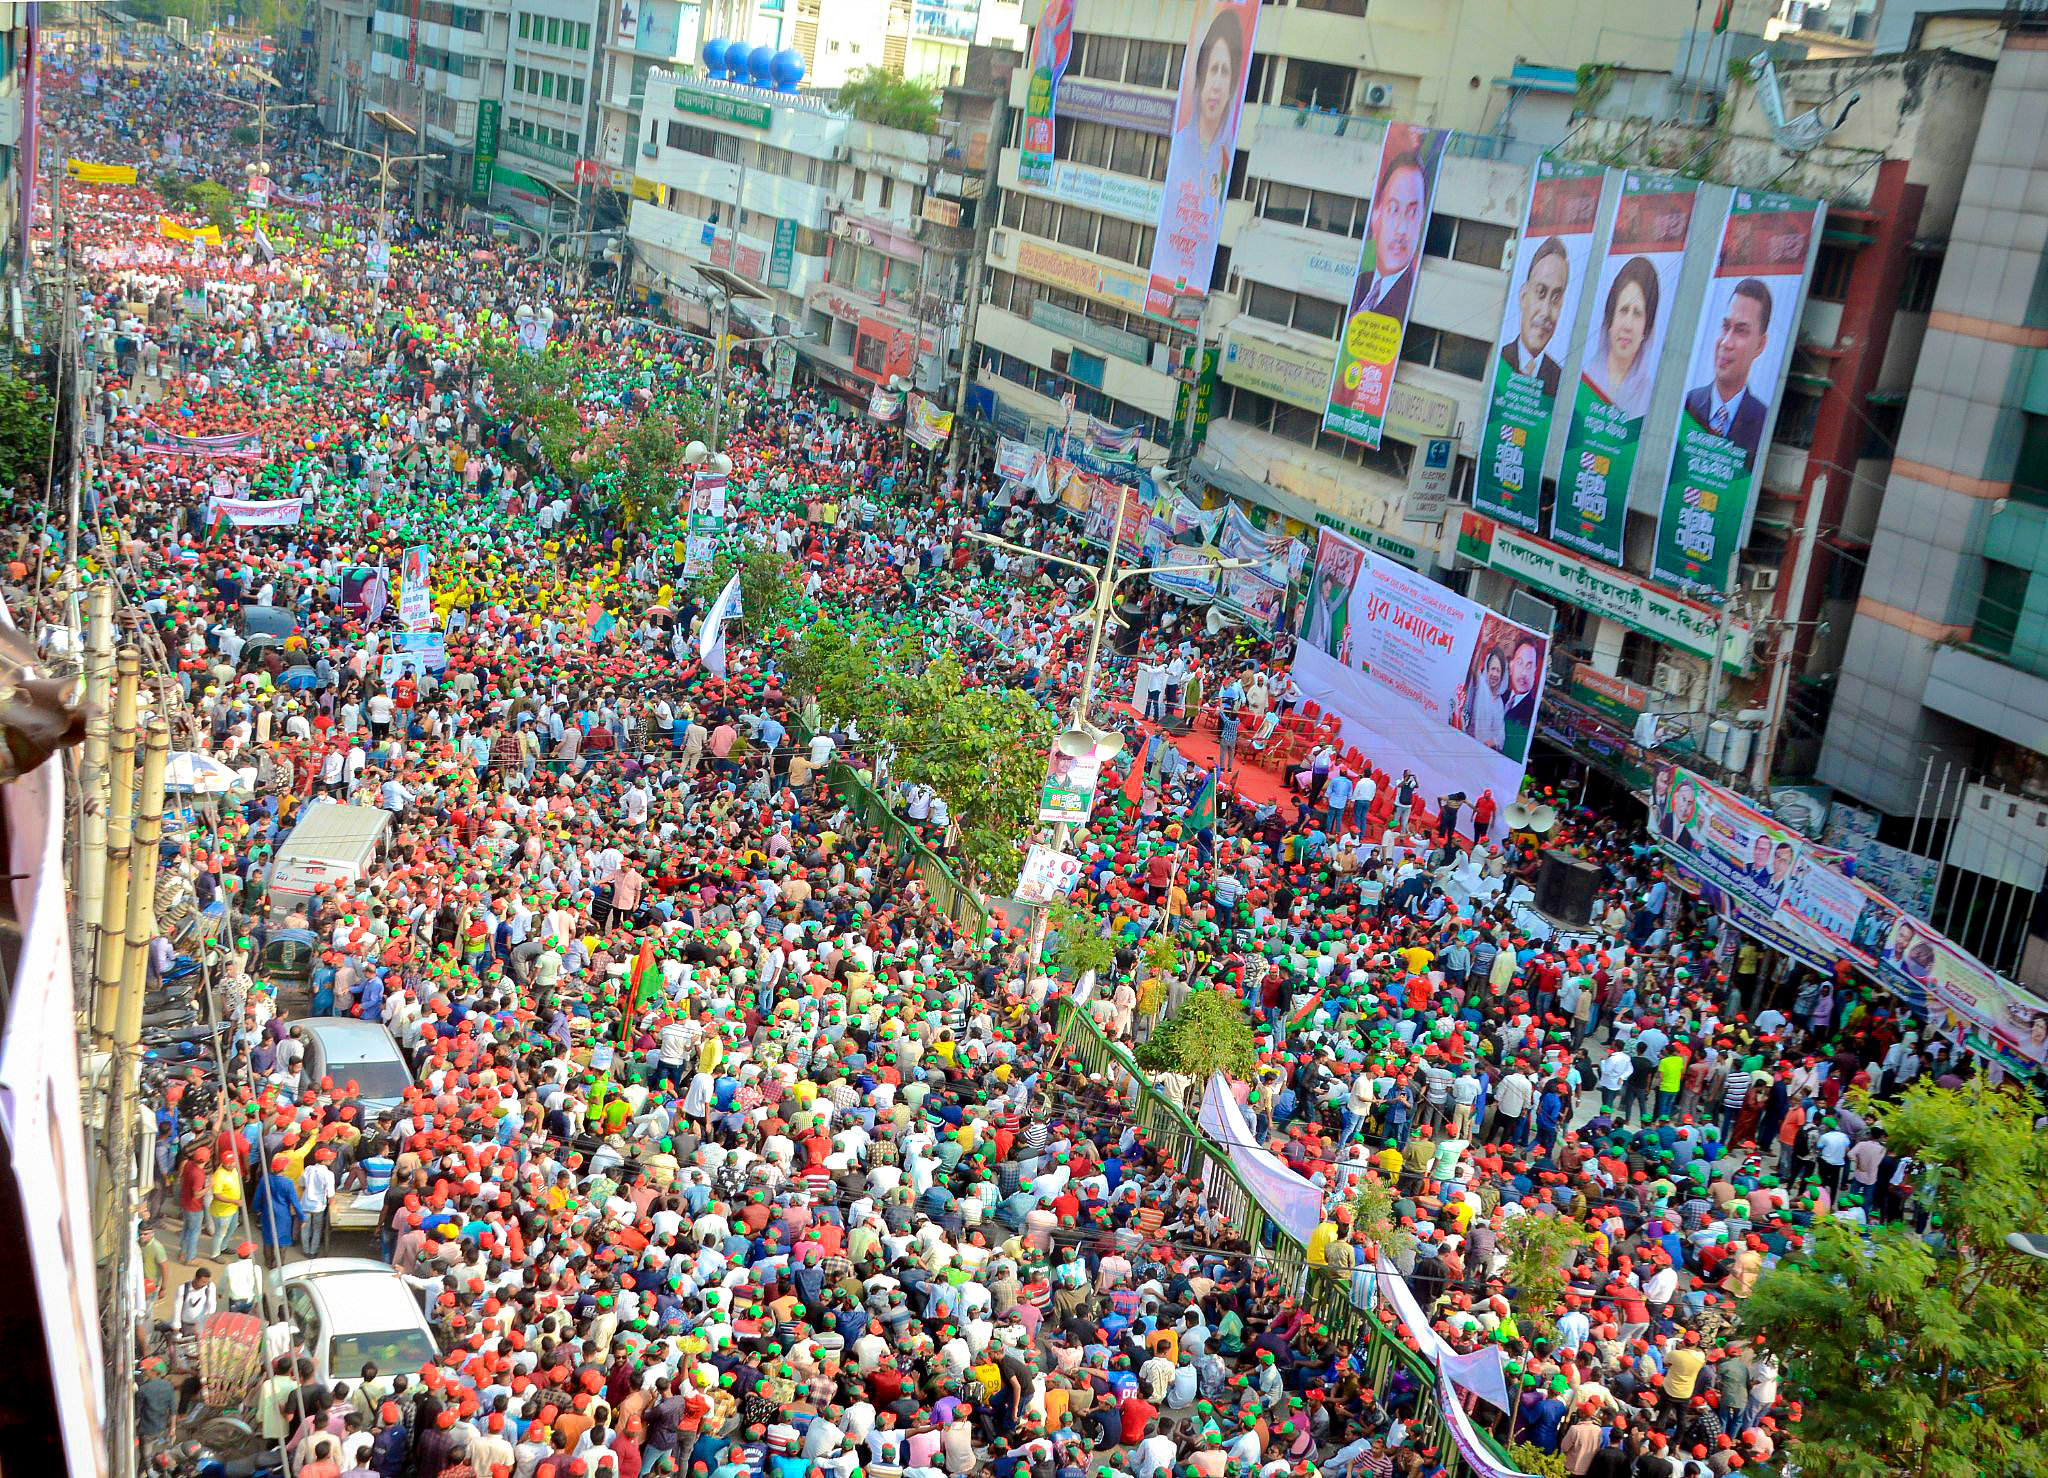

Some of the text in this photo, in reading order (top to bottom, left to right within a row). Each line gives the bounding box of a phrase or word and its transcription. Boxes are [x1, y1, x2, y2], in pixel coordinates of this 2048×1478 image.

[1415, 502, 1438, 513] LIMITED
[1315, 512, 1416, 559] PUBALI BANK LIMITED
[1498, 537, 1554, 572] বাংলাদেশ
[1558, 562, 1644, 610] জাতীয়তাবাদী
[1367, 592, 1391, 622] যুব
[1392, 605, 1455, 655] সমাবেশ
